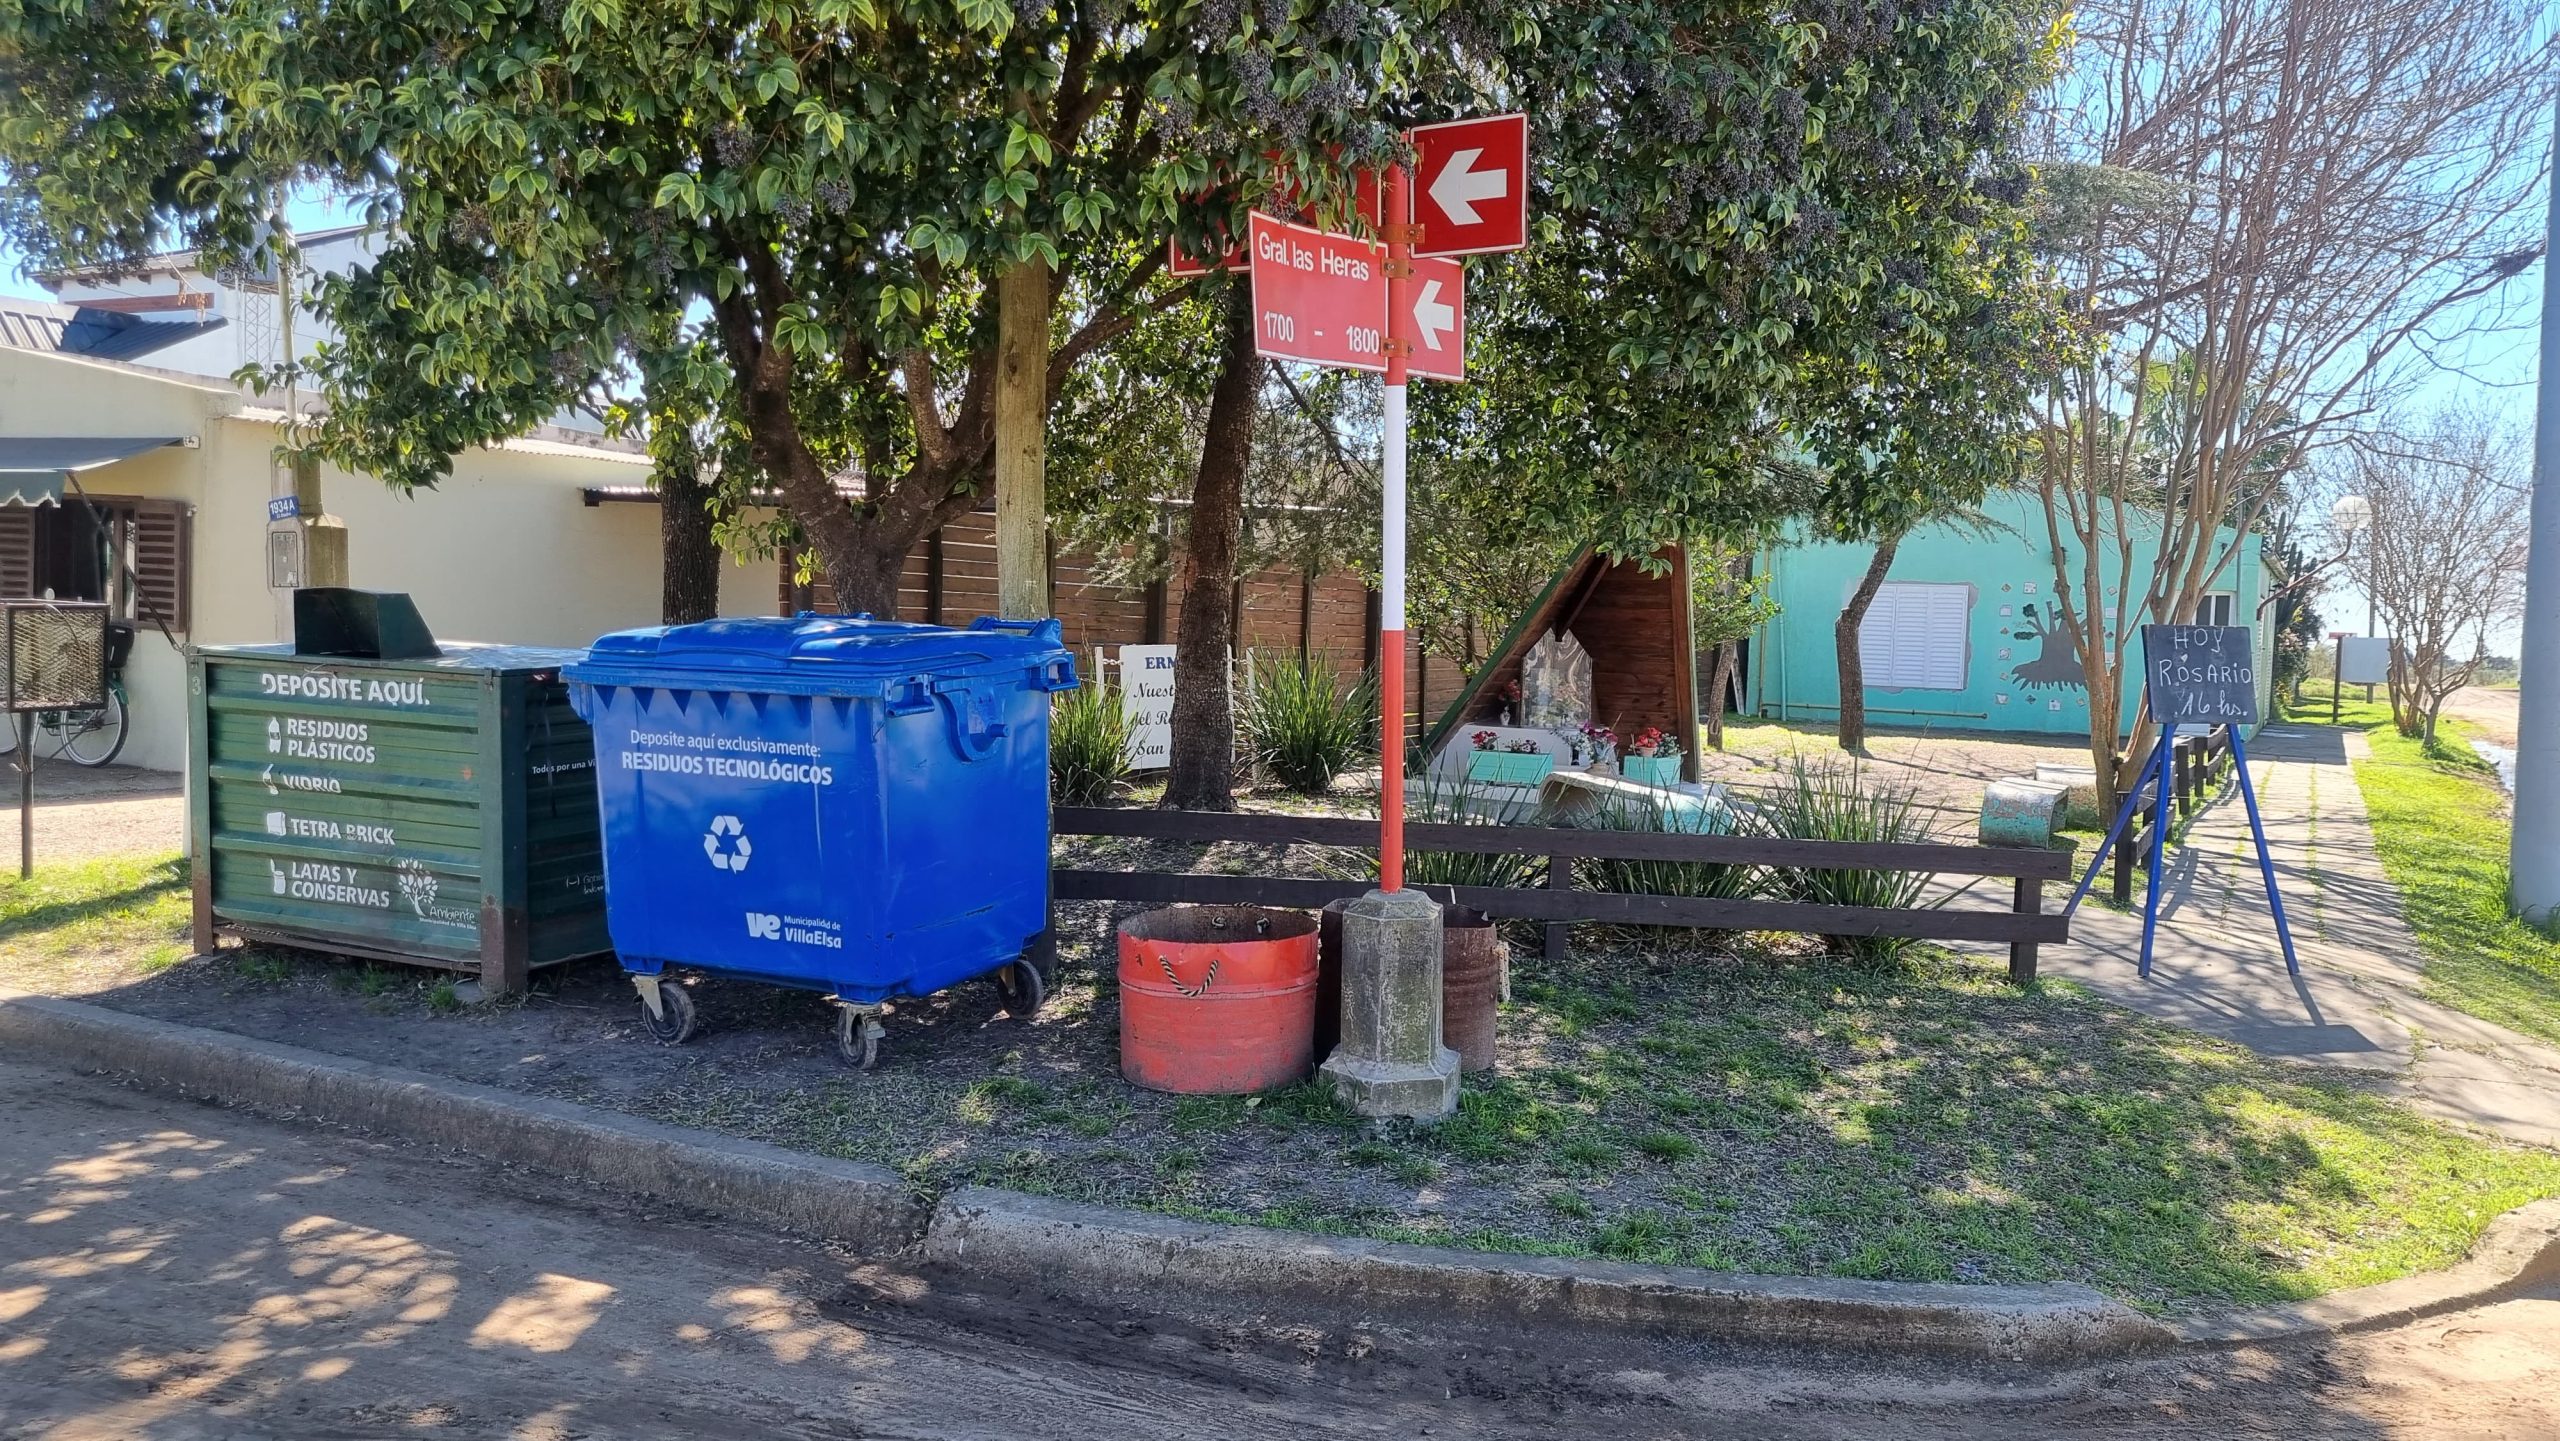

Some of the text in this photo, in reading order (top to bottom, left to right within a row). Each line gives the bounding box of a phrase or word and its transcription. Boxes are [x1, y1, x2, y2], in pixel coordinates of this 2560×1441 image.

[1258, 231, 1290, 267] Gral.
[1292, 241, 1314, 272] las
[1320, 247, 1369, 282] Heras
[1264, 311, 1294, 343] 1700
[1345, 326, 1380, 354] 1800
[261, 673, 430, 707] DEPOSITE AQUÍ.
[287, 718, 368, 742] RESIDUOS
[630, 729, 821, 758] Deposite aquí exclusivamente:
[287, 738, 376, 764] PLÁSTICOS
[556, 763, 571, 773] por
[571, 761, 586, 770] una
[622, 751, 833, 786] RESIDUOS TECNOLÓGICOS
[290, 818, 396, 846] TETRA BRICK
[292, 862, 359, 885] LATAS Y
[291, 881, 390, 908] CONSERVAS
[831, 921, 841, 931] de
